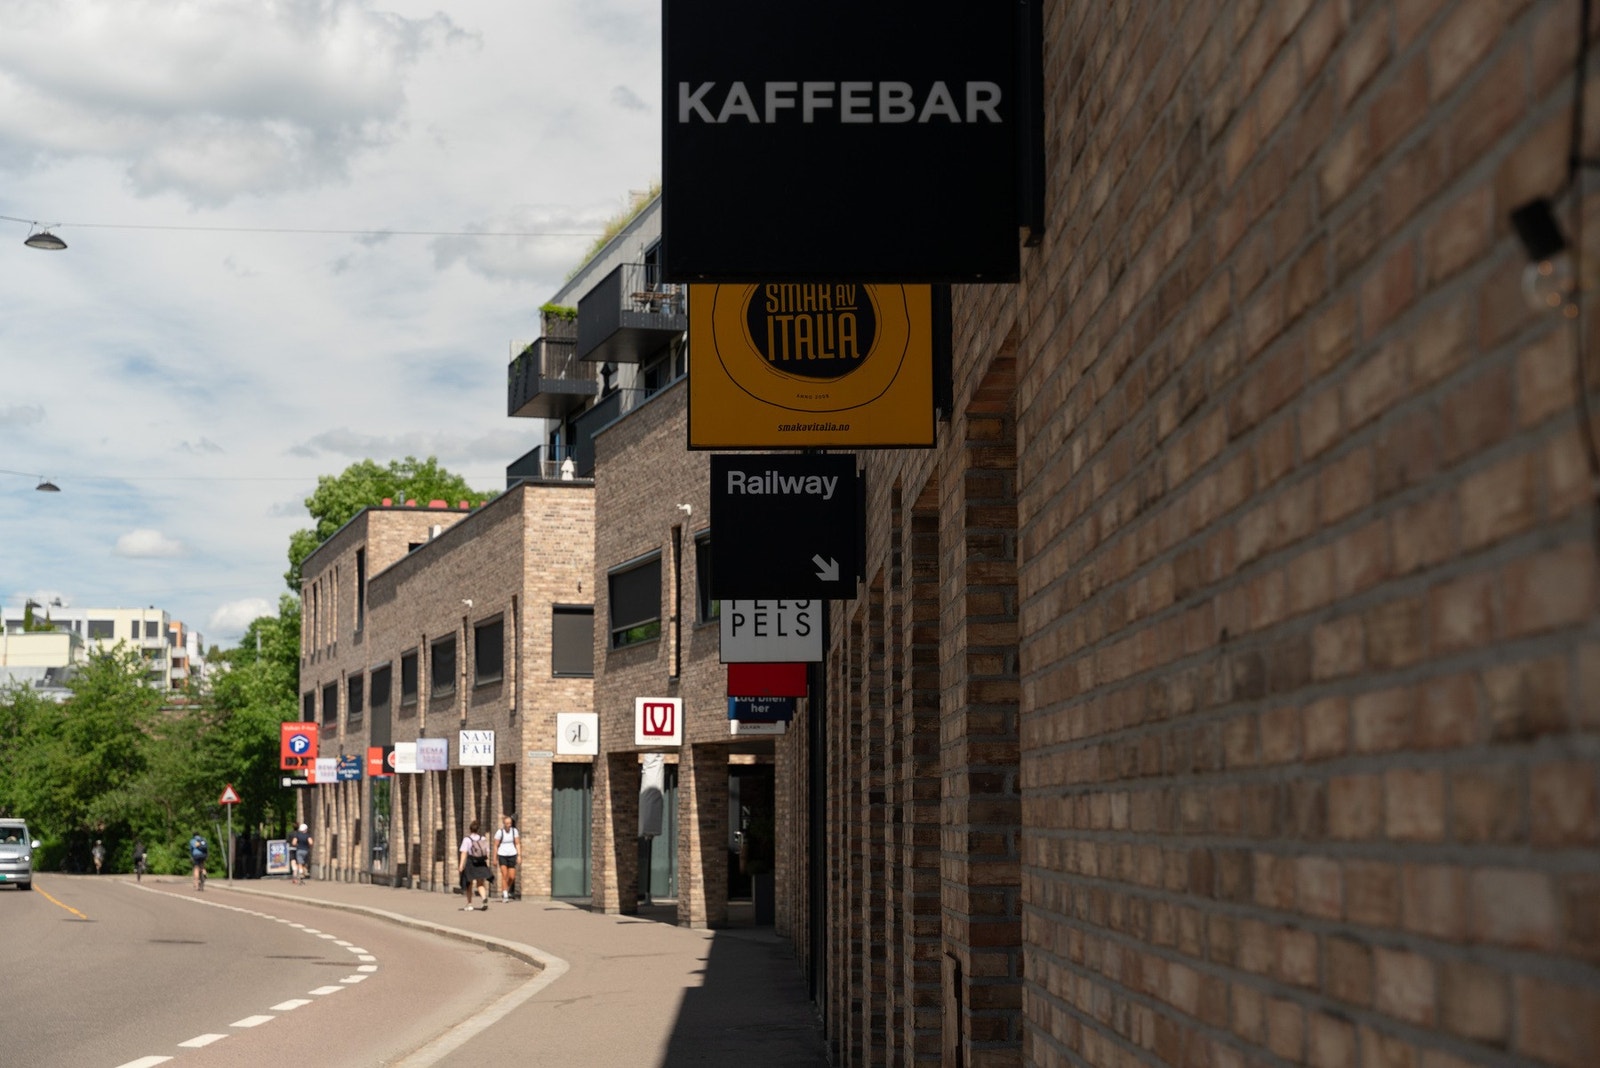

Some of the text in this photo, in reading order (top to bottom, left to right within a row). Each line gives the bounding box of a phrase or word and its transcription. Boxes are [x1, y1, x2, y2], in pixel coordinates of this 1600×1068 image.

[678, 81, 1003, 123] KAFFEBAR
[766, 313, 860, 361] ITALIA
[777, 422, 850, 433] smakavitalia.no
[727, 470, 839, 500] Railway
[732, 612, 811, 637] PELS
[751, 703, 770, 713] her
[462, 732, 492, 741] NAM
[462, 744, 492, 754] FAH
